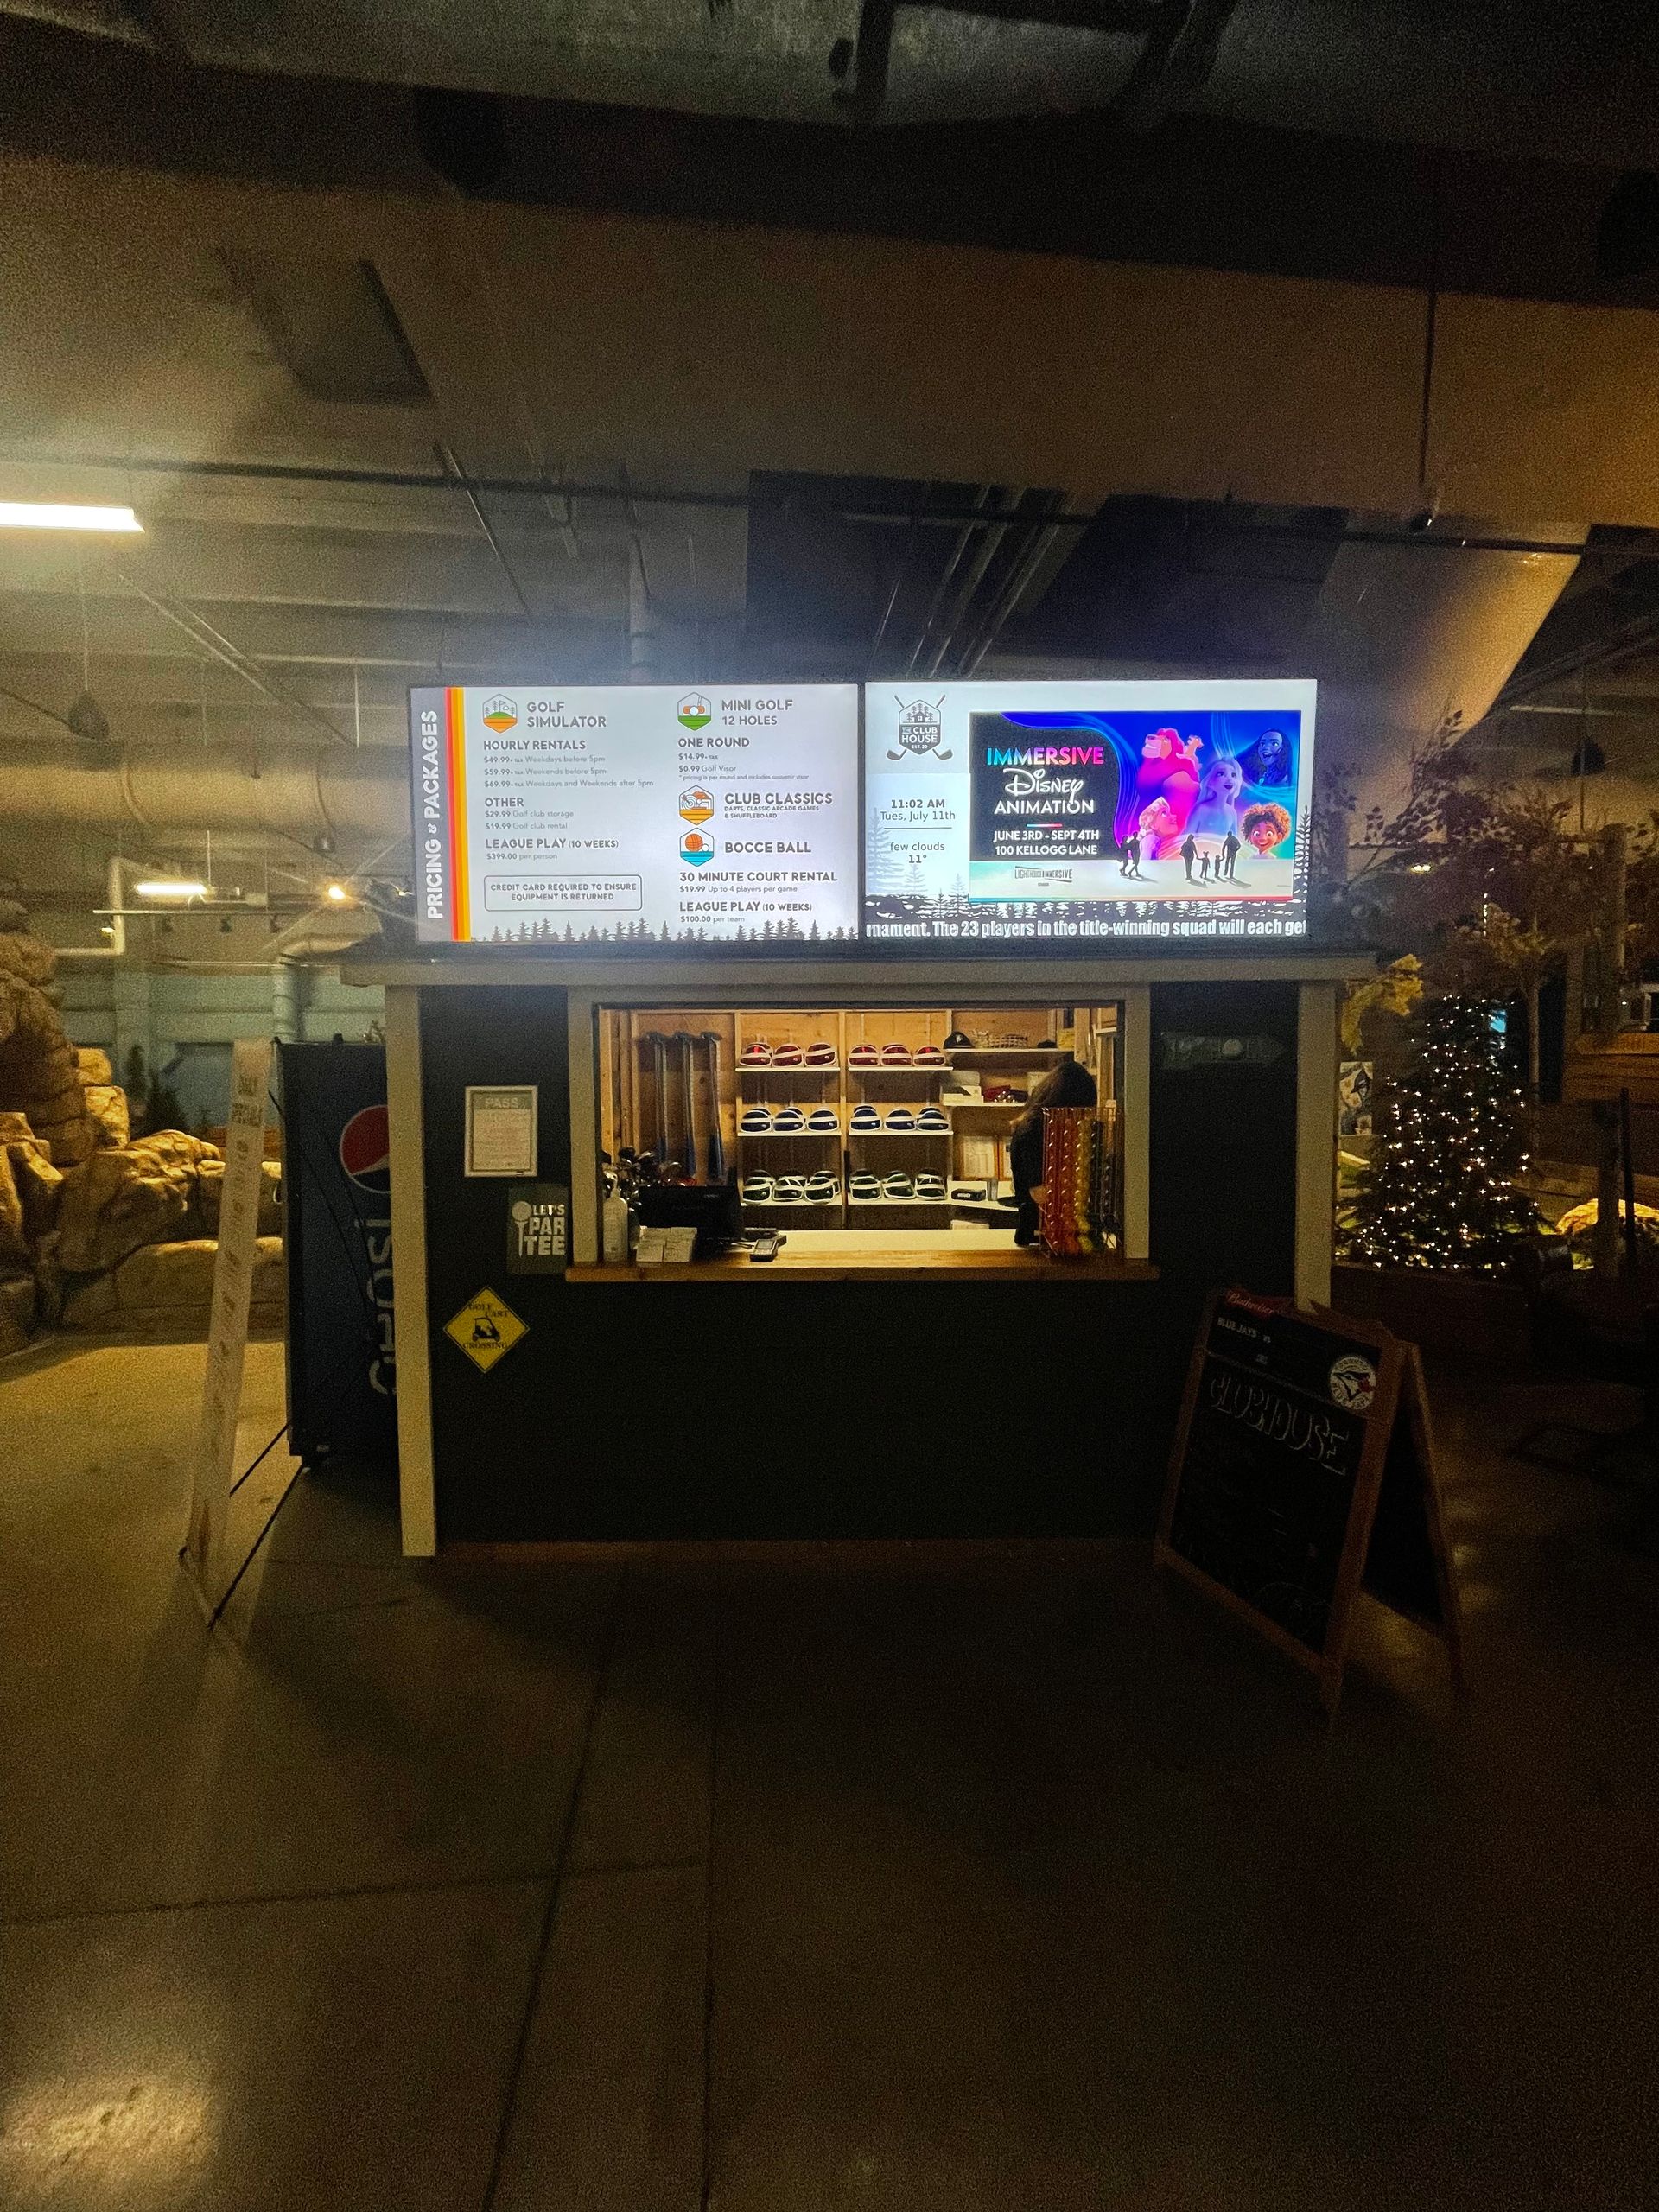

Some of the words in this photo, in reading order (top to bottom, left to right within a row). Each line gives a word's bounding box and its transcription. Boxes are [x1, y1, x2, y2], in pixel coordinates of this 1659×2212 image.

[527, 702, 564, 713] GOLF
[721, 700, 751, 710] MINI
[755, 699, 793, 710] GOLF
[527, 716, 607, 728] SIMULATOR
[722, 716, 734, 726] 12
[739, 715, 778, 726] HOLES
[678, 738, 703, 747] ONE
[707, 737, 749, 747] ROUND
[901, 734, 938, 743] HOUSE
[484, 741, 530, 751] HOURLY
[533, 741, 586, 750] RENTALS
[589, 755, 606, 765] 5pm
[987, 747, 1104, 766] IMMERSIVE
[421, 710, 441, 819] PACKAGES
[590, 768, 607, 777] 5pm
[637, 779, 653, 788] 5pm
[1003, 767, 1084, 804] Disney
[485, 798, 524, 807] OTHER
[724, 793, 760, 804] CLUB
[765, 792, 833, 804] CLASSICS
[891, 799, 923, 808] 11:02
[927, 799, 945, 808] AM
[994, 799, 1095, 814] ANIMATION
[547, 810, 574, 819] storage
[880, 811, 907, 821] Tues,
[909, 811, 931, 823] July
[933, 811, 956, 820] 11th
[427, 823, 439, 834] &
[993, 830, 1020, 843] JUNE
[1022, 830, 1043, 841] 3RD
[1051, 830, 1077, 841] SEPT
[1077, 830, 1100, 840] 4TH
[486, 838, 533, 849] LEAGUE
[537, 838, 567, 849] PLAY
[569, 839, 582, 849] (10
[584, 839, 619, 849] WEEKS)
[725, 842, 773, 853] BOCCE
[777, 842, 811, 853] BALL
[890, 842, 908, 851] few
[912, 842, 945, 851] clouds
[995, 846, 1014, 855] 100
[1016, 845, 1067, 855] KELLOGG
[1069, 845, 1097, 855] LANE
[908, 854, 927, 863] 11°
[425, 839, 443, 919] PRICING
[680, 872, 695, 882] 30
[698, 872, 744, 881] MINUTE
[747, 872, 788, 881] COURT
[791, 872, 837, 881] RENTAL
[547, 883, 589, 892] REQUIRED
[736, 885, 762, 893] players
[680, 902, 728, 912] LEAGUE
[730, 901, 760, 912] PLAY
[762, 903, 775, 912] (10
[778, 903, 812, 912] WEEKS)
[932, 921, 958, 936] The
[961, 921, 979, 937] 23
[982, 920, 1035, 938] players
[1038, 920, 1051, 936] in
[1053, 920, 1077, 936] the
[1079, 919, 1169, 938] title-winning
[1173, 919, 1217, 937] squad
[1218, 919, 1245, 935] will
[1247, 918, 1282, 935] each
[532, 1204, 565, 1216] LET'S
[529, 1217, 566, 1235] PAR
[524, 1236, 566, 1255] TEE
